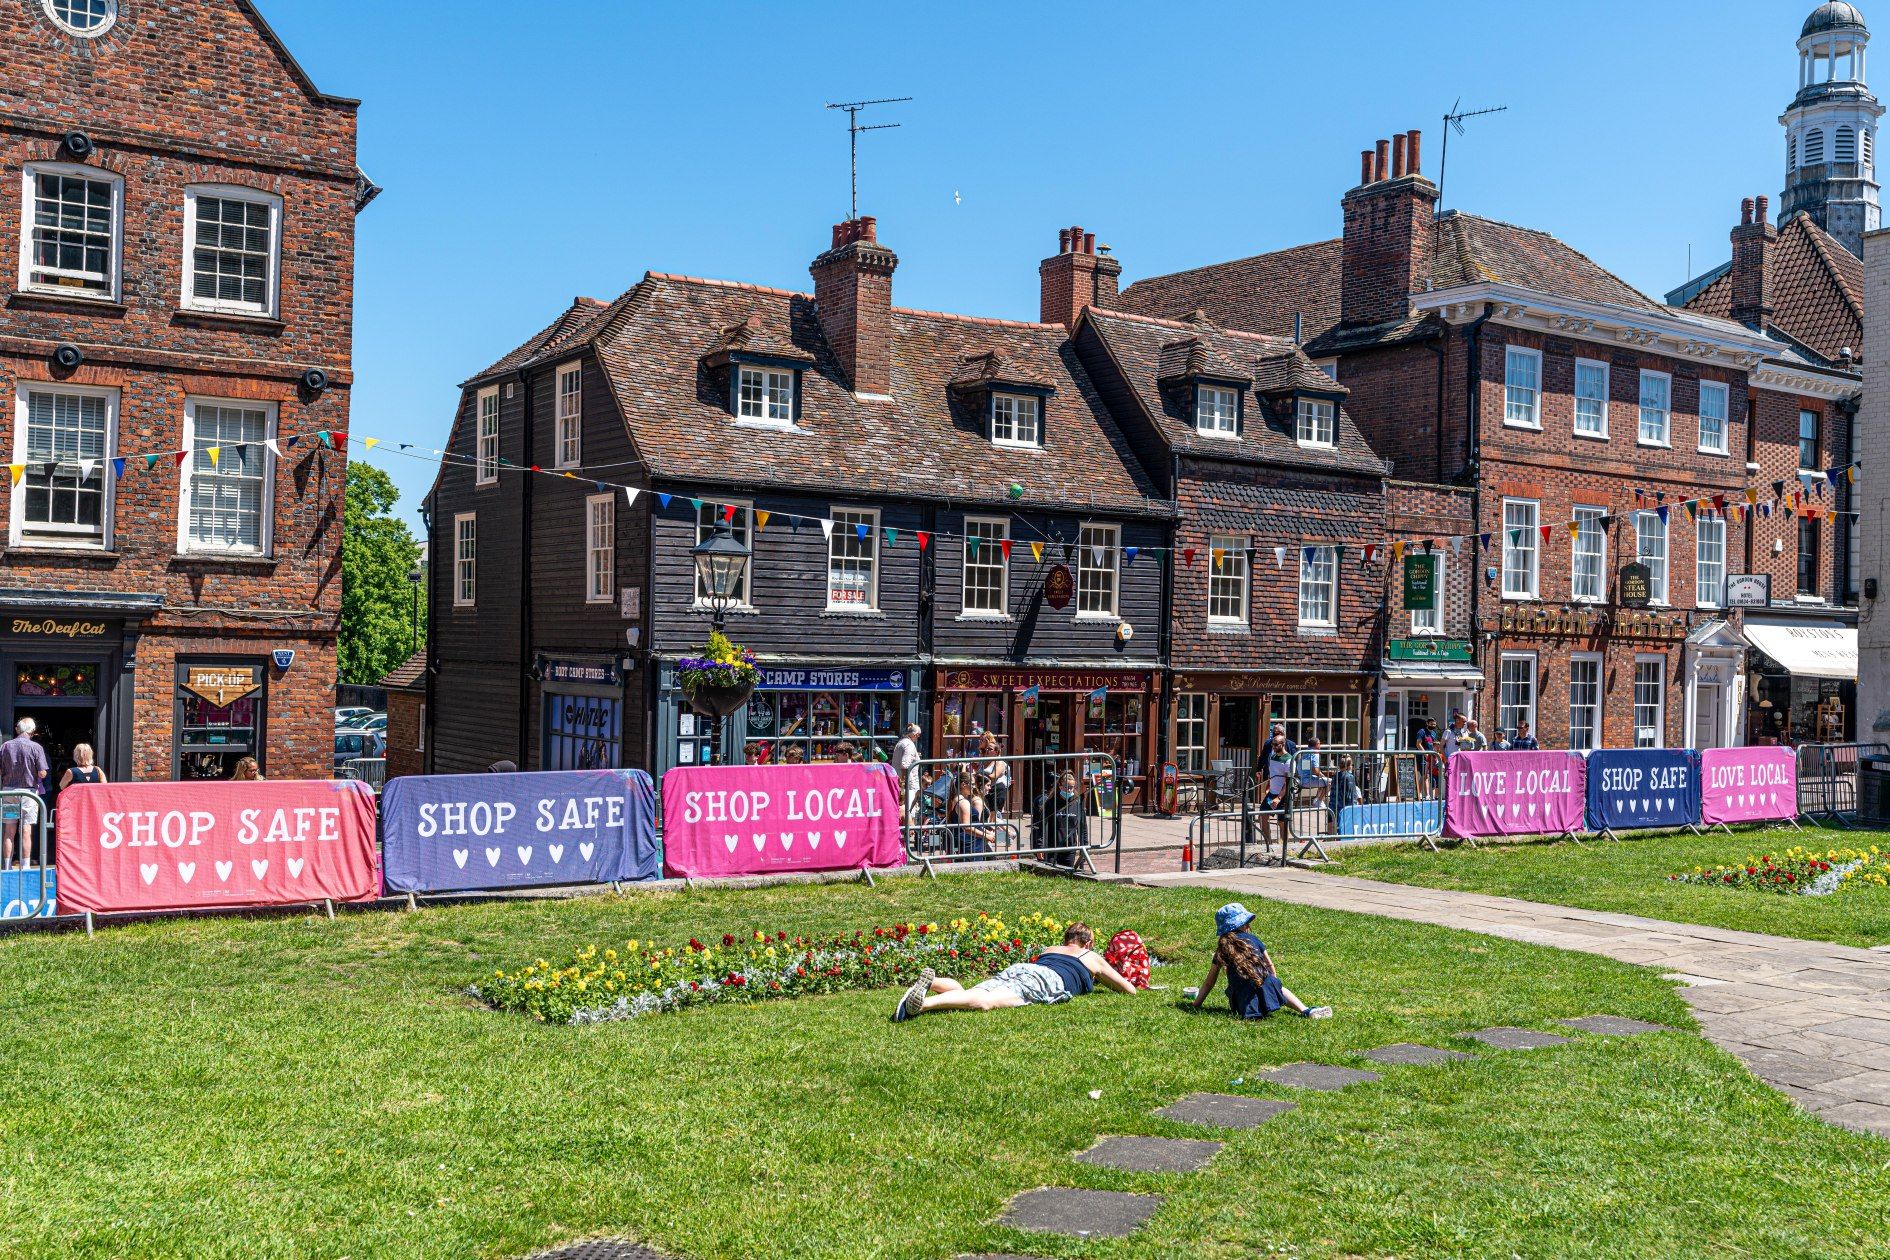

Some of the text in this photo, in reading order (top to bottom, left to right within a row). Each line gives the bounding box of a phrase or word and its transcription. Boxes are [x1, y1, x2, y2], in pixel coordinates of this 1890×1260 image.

[832, 590, 865, 600] FOR SALE
[12, 619, 105, 637] The Deaf Cat
[1503, 606, 1681, 638] GORDON HOTEL
[197, 673, 245, 687] PICK-UP
[555, 666, 605, 679] BOOT CAMP STORES
[766, 671, 859, 685] CAMP STORES
[983, 675, 1118, 687] SWEET EXPECTATIONS
[1248, 676, 1286, 689] Rochester
[218, 689, 223, 702] 1
[1459, 769, 1571, 797] LOVE LOCAL
[1602, 766, 1687, 792] SHOP SAFE
[1711, 763, 1788, 788] LOVE LOCAL
[684, 788, 882, 824] SHOP LOCAL
[418, 796, 625, 837] SHOP SAFE
[100, 808, 340, 849] SHOP SAFE
[1404, 819, 1439, 840] LOC
